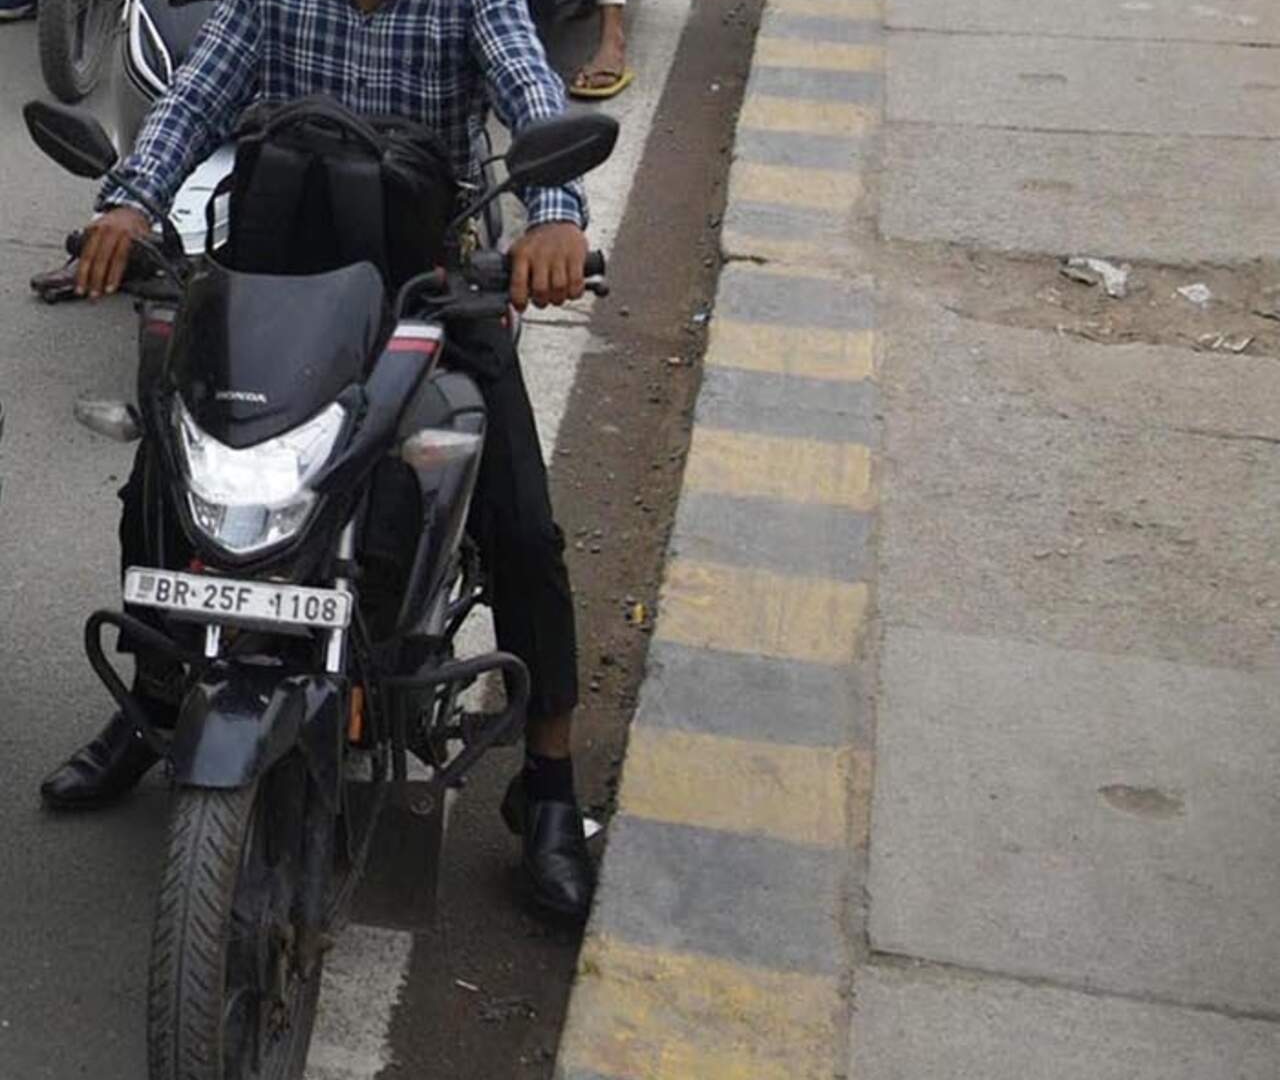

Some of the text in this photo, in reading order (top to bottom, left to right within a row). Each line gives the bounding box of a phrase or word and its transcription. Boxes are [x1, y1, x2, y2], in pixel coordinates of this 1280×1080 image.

[215, 391, 268, 403] HONDA
[155, 578, 190, 606] BR
[203, 585, 252, 612] 25F
